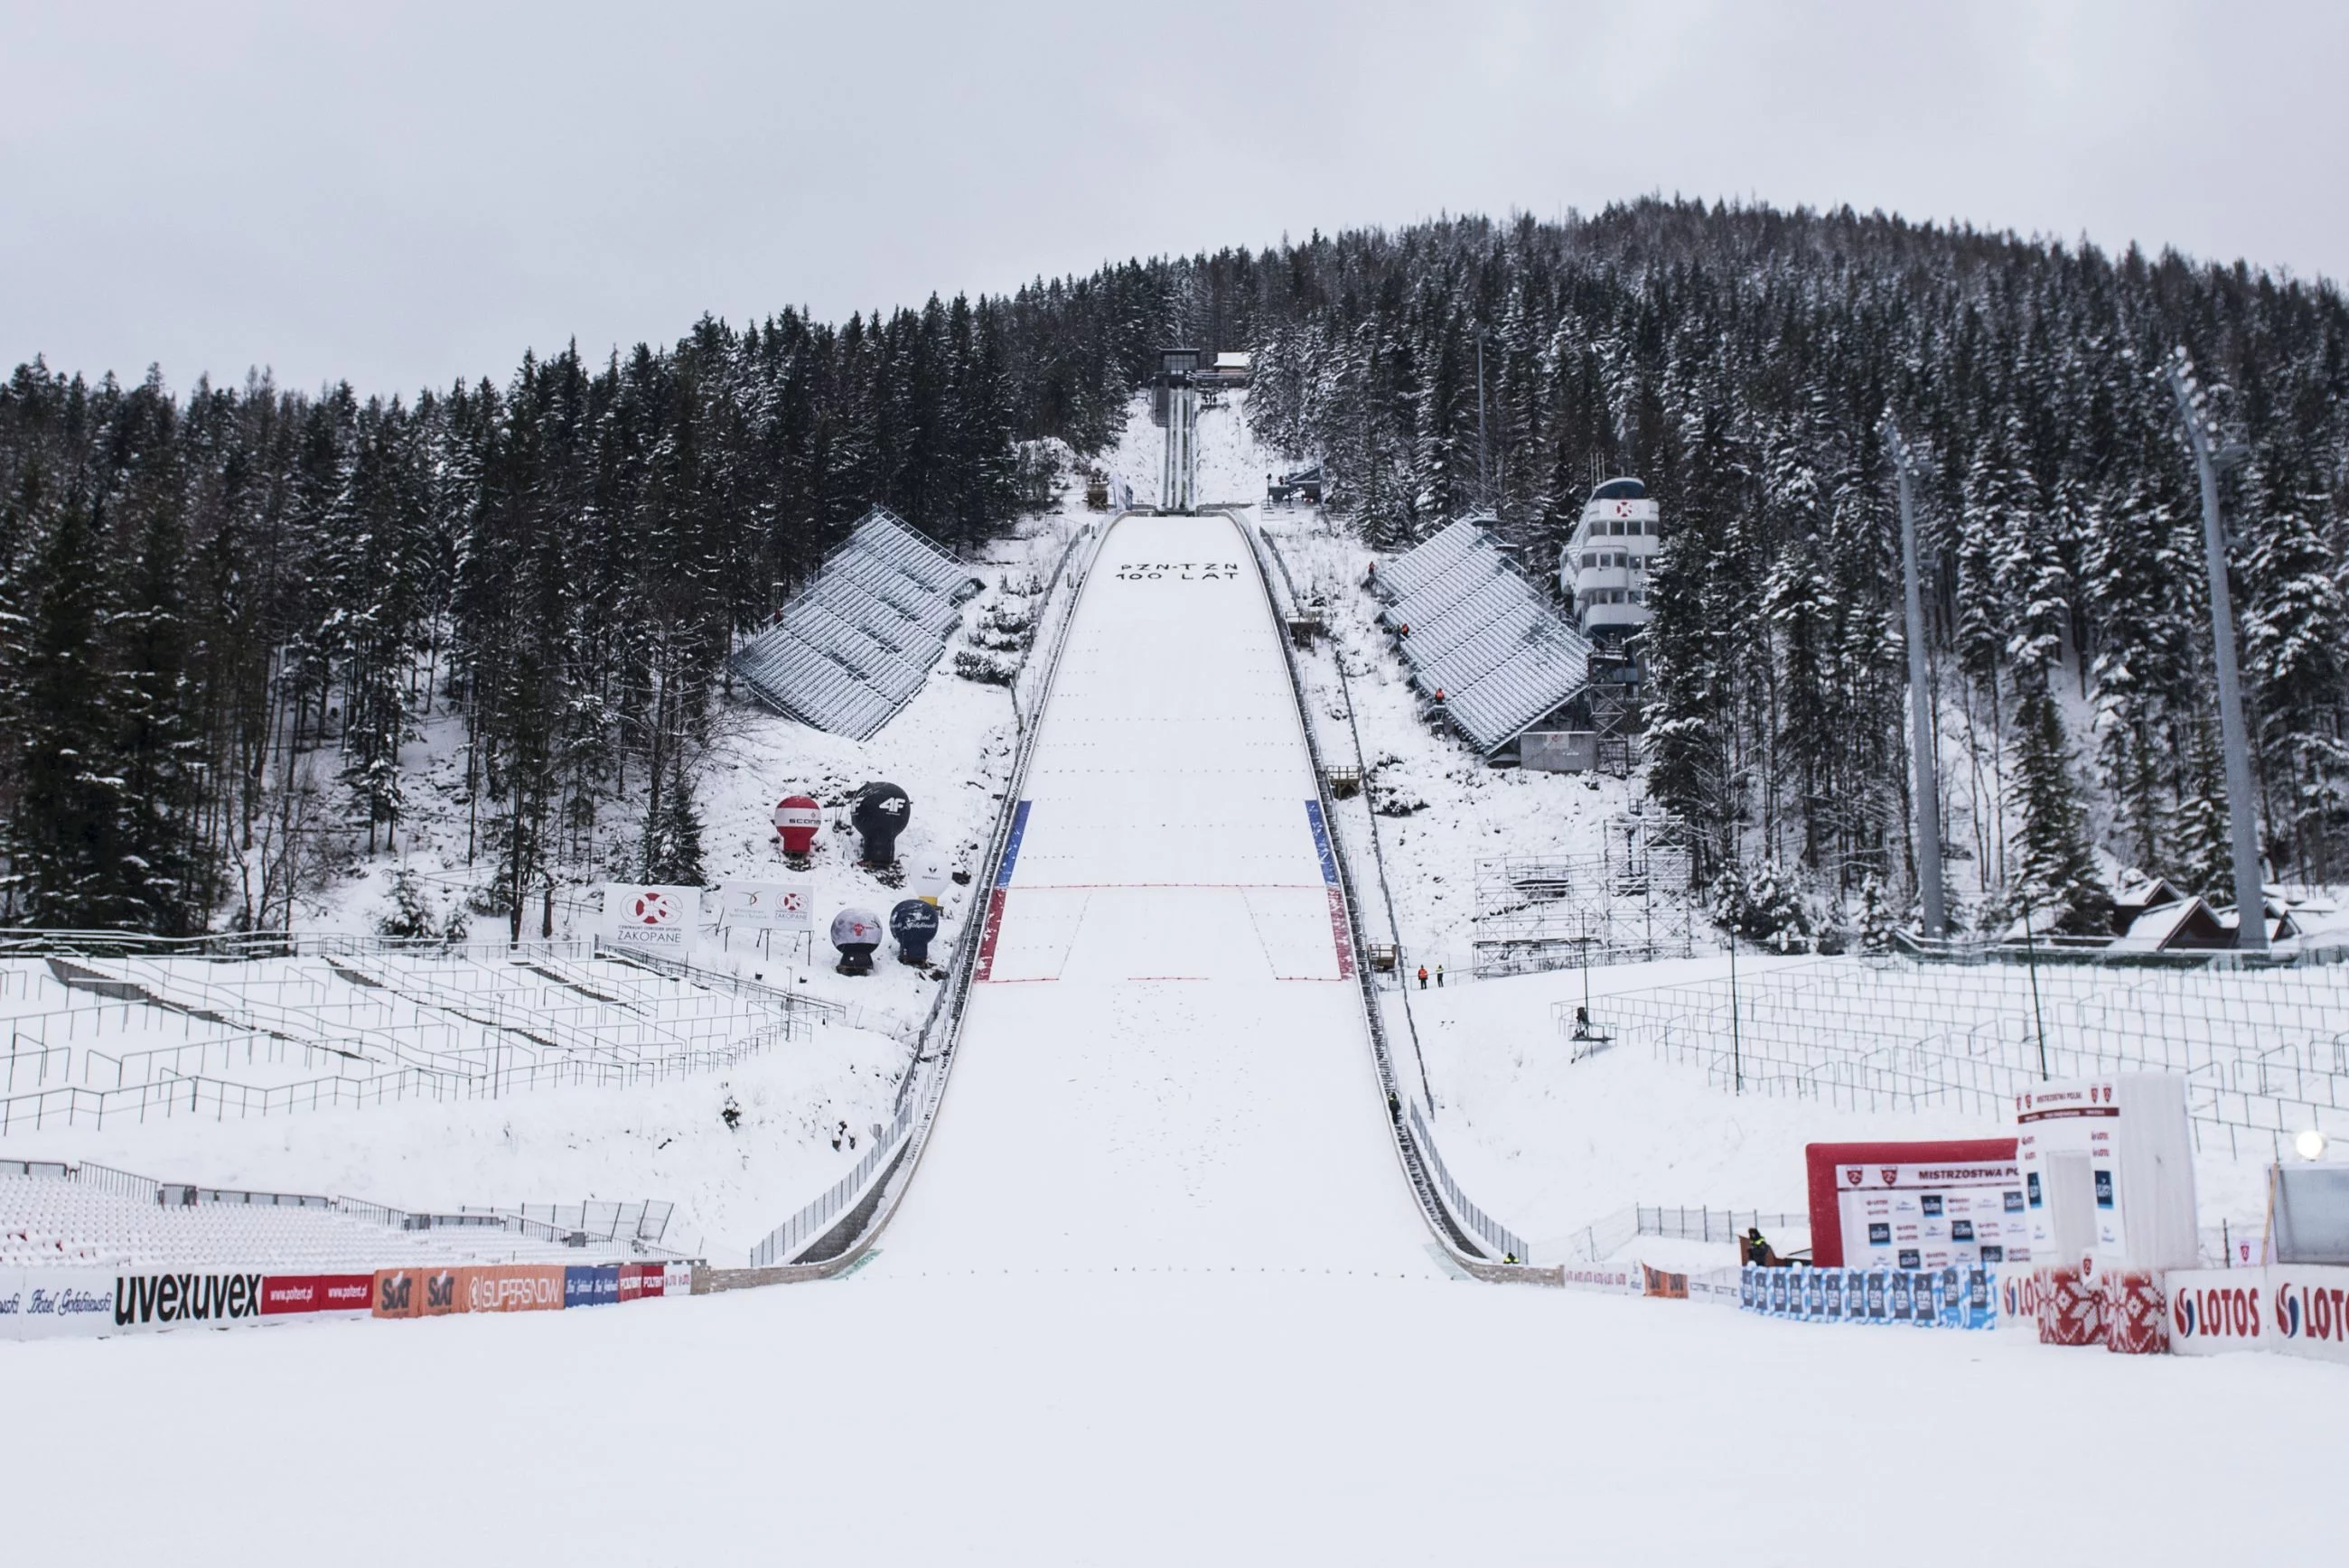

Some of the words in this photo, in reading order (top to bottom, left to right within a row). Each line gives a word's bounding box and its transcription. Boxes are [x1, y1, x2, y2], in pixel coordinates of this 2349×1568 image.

[879, 797, 905, 813] 4F
[775, 912, 808, 920] ZAKOPANE
[617, 930, 681, 943] ZAKOPANE
[1919, 1169, 2002, 1180] MISTRZOSTWA
[482, 1278, 561, 1308] SUPERSNOW
[2197, 1287, 2260, 1338] LOTOS
[2302, 1285, 2349, 1342] LOT
